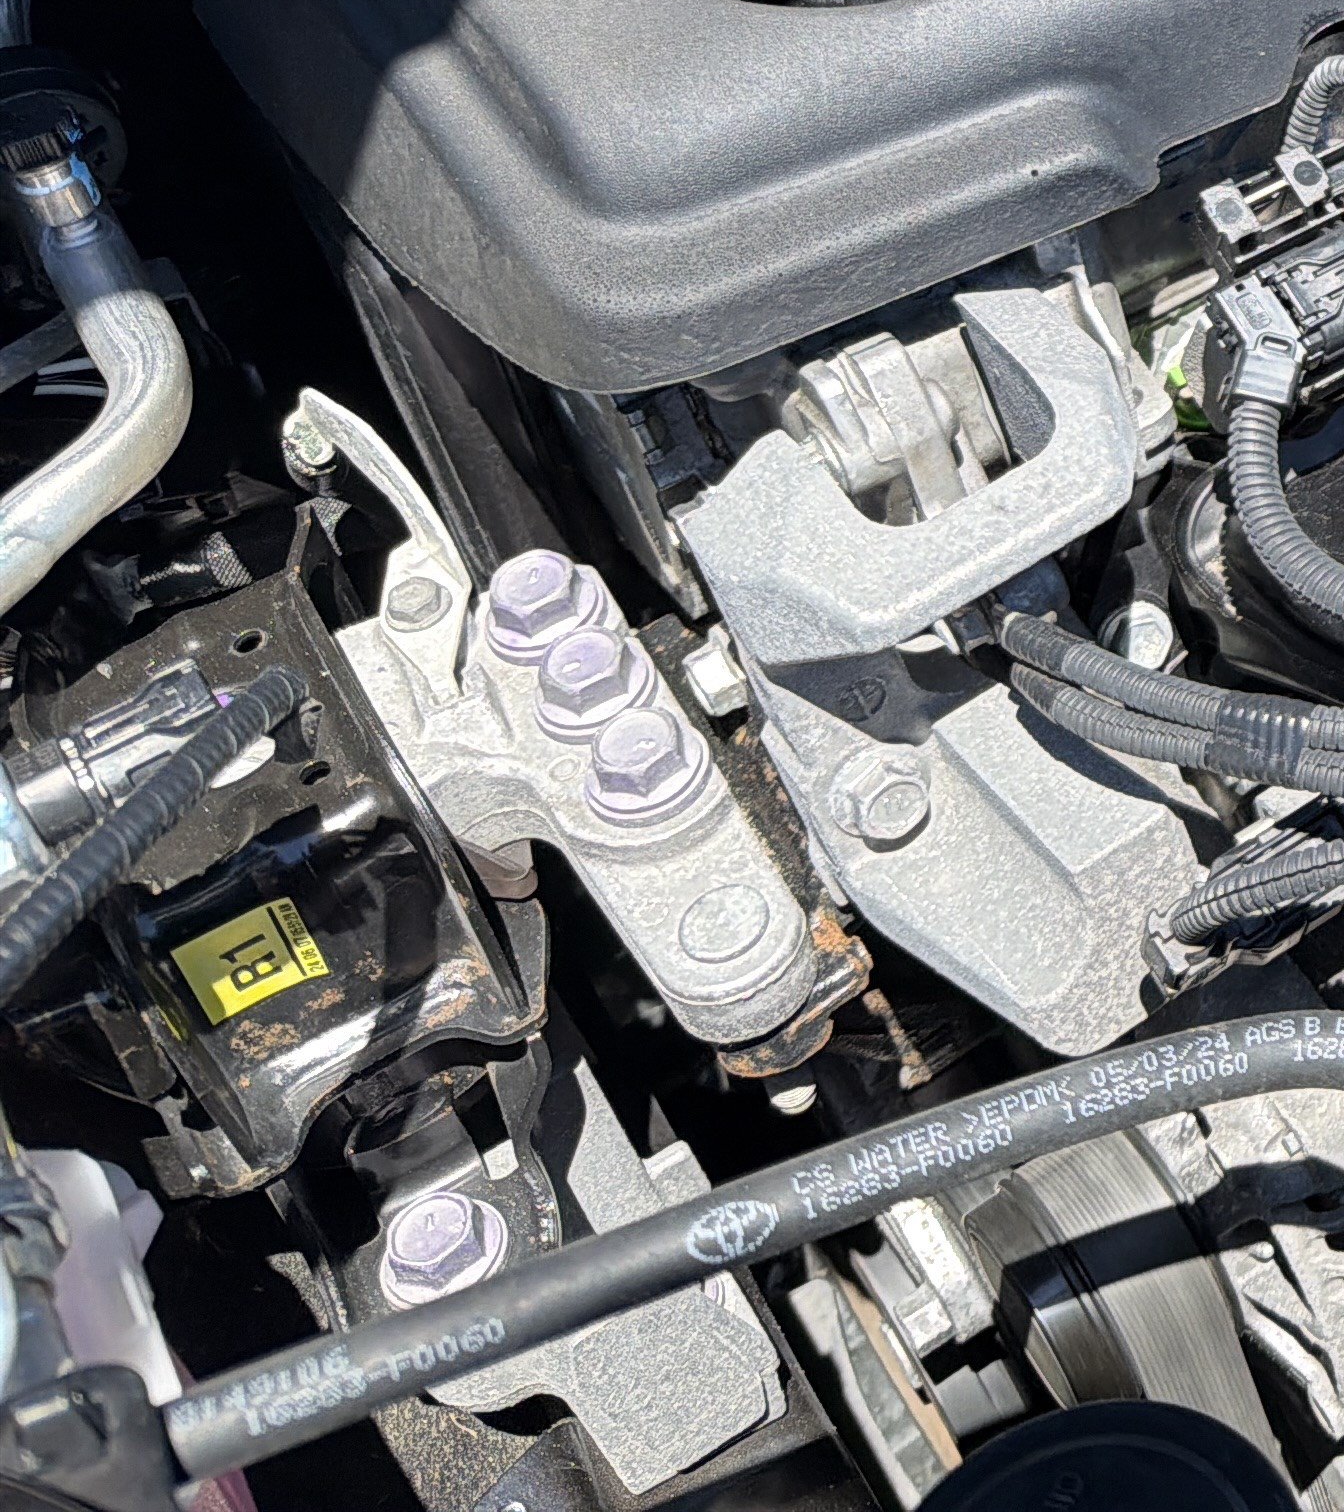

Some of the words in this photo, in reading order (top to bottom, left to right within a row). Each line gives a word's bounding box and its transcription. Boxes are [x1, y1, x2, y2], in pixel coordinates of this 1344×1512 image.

[219, 933, 282, 992] R1
[791, 1166, 837, 1196] CS
[848, 1121, 951, 1175] WATER
[1089, 1032, 1232, 1088] 05/03/24
[1245, 1018, 1295, 1046] AGS
[801, 1124, 1014, 1224] 16283-F0060
[1060, 1052, 1251, 1126] 16283-F0060
